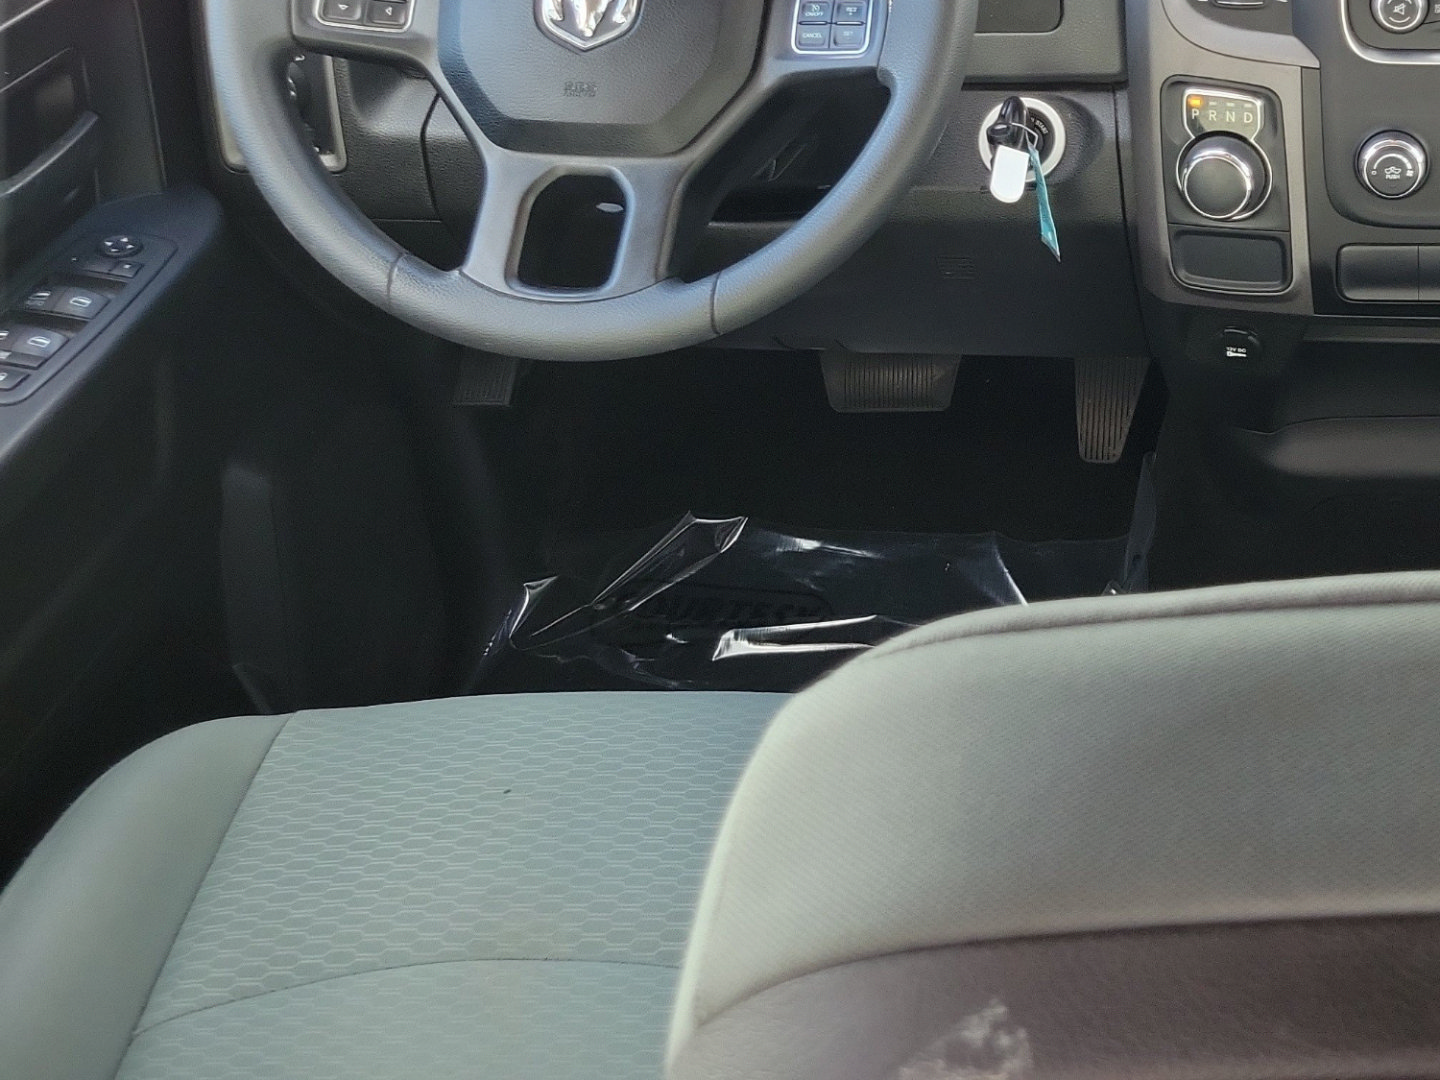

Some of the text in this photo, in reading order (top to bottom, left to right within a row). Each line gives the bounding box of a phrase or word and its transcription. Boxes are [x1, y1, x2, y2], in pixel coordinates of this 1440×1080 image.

[1191, 108, 1253, 123] P R N D
